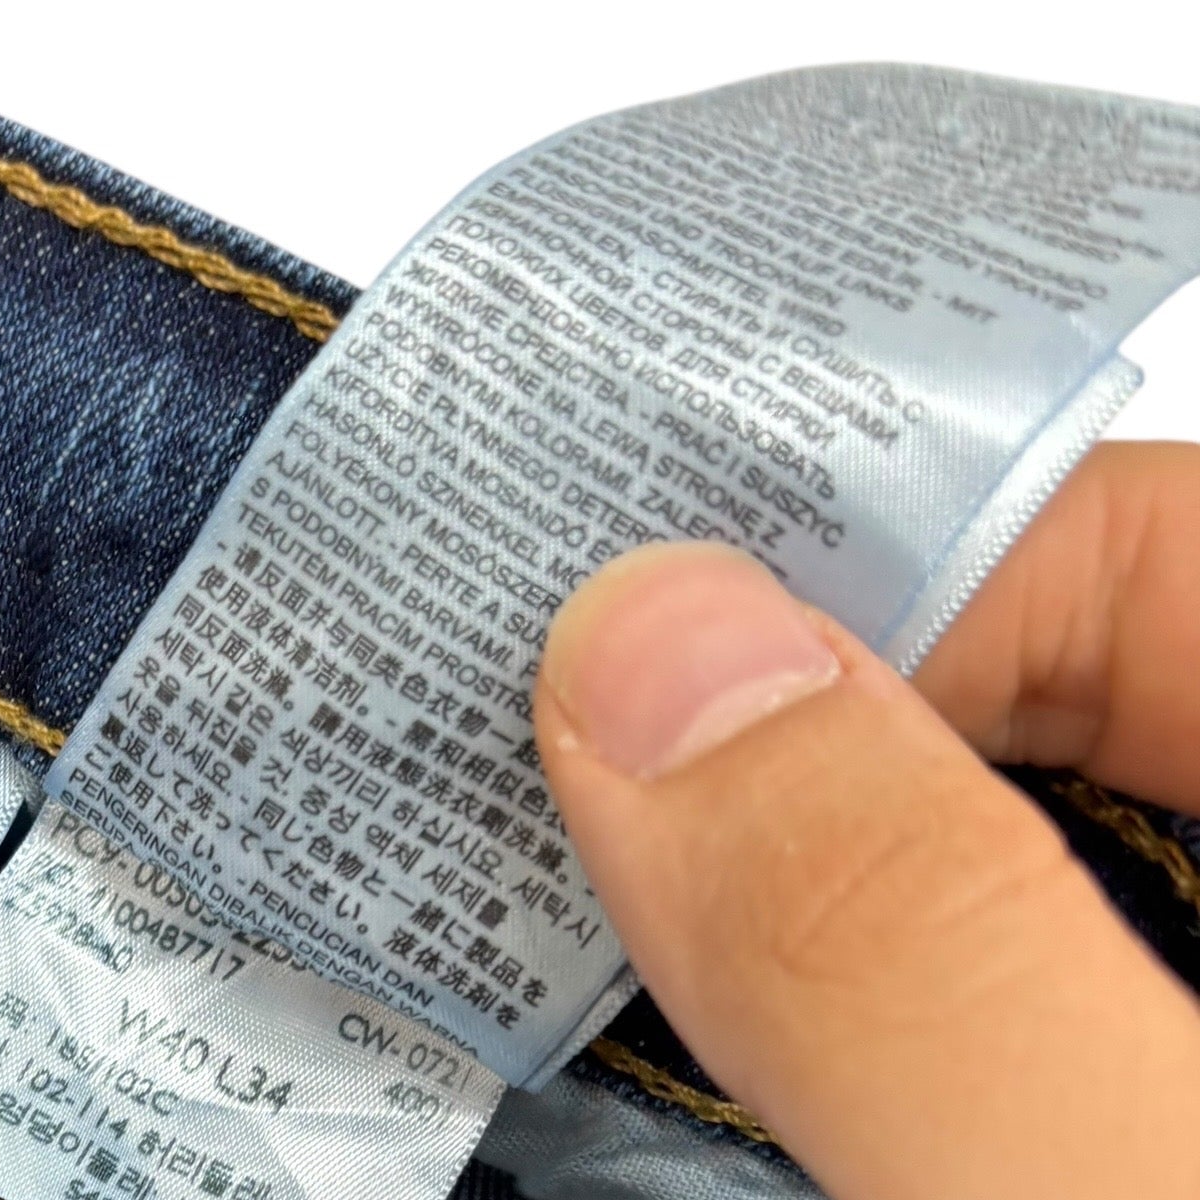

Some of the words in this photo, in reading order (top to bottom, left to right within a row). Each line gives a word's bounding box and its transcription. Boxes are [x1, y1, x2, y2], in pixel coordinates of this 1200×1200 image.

[646, 206, 705, 244] UND
[779, 245, 837, 280] AUF
[401, 258, 511, 334] ЖИДКИЕ
[445, 210, 575, 295] ПОХОЖИХ
[668, 342, 731, 389] ДЛЯ
[650, 266, 765, 337] СТИРАТЬ
[343, 336, 433, 406] UŻYCIE
[429, 391, 563, 495] PŁYNNEGO
[364, 309, 504, 417] PODOBNYMI
[383, 283, 545, 399] WYWRÓCONE
[541, 385, 581, 423] NA
[578, 411, 654, 471] LEWĄ
[651, 451, 764, 540] STRONĘ
[758, 520, 787, 550] Z
[424, 233, 637, 373] РЕКОМЕНДОВАНО
[633, 358, 842, 502] ИСПОЛЬЗОВАТЬ
[248, 473, 273, 500] S
[284, 418, 427, 528] FOLYÉKONY
[301, 390, 421, 480] HASONLÓ
[322, 362, 463, 469] KIFORDÍTVA
[459, 456, 590, 552] MOSANDÓ
[232, 501, 340, 591] TEKUTÉM
[336, 578, 425, 654] PRACÍM
[398, 541, 483, 610] PERTE
[477, 596, 503, 622] A
[230, 541, 561, 778] 请反面并与同类色衣物一起
[150, 622, 229, 699] 세탁시
[272, 723, 391, 813] 색상끼리
[508, 871, 600, 952] 세탁시
[256, 753, 299, 796] 것.
[296, 781, 360, 837] 중성
[360, 820, 423, 876] 액체
[67, 767, 208, 888] PENGERINGAN
[207, 881, 294, 944] DIBALIK
[294, 938, 394, 1004] DENGAN
[248, 878, 381, 975] PENCUCIAN
[381, 967, 435, 1009] DAN
[16, 1056, 132, 1142] 102-114
[108, 995, 214, 1078] W40
[211, 1053, 296, 1118] L34
